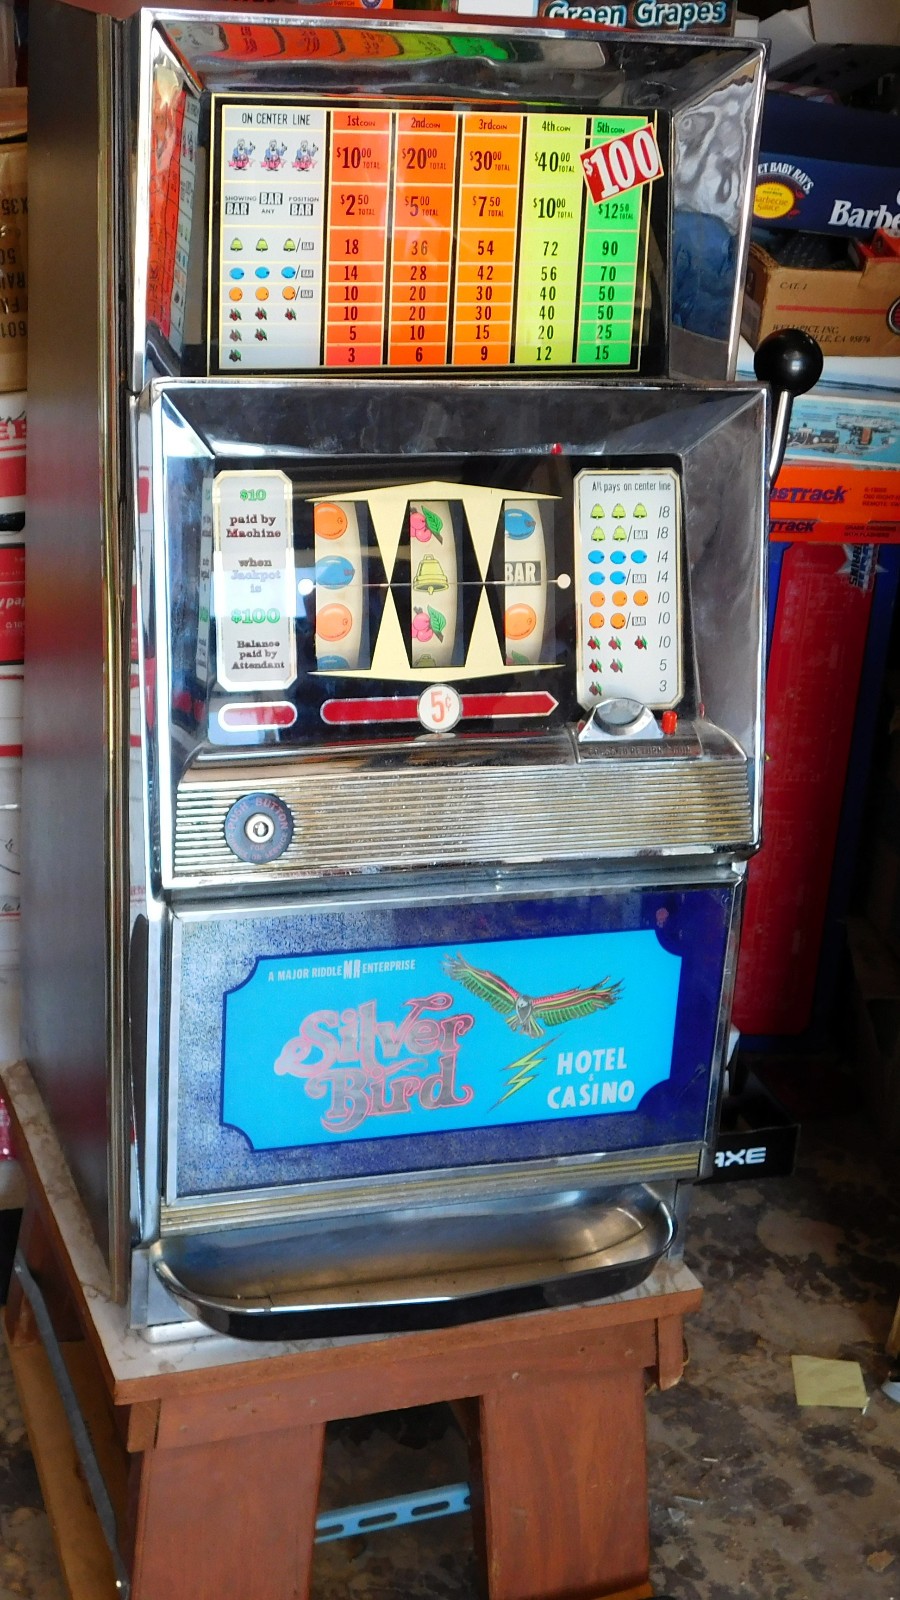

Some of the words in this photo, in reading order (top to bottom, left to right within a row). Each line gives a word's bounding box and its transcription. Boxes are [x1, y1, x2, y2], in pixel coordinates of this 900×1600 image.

[544, 2, 627, 27] Green
[633, 0, 727, 31] Grapes
[241, 113, 252, 124] ON
[256, 114, 288, 125] CENTER
[293, 114, 311, 126] LINE
[541, 120, 555, 132] 4th
[597, 122, 610, 133] 5th
[363, 161, 380, 169] TOTAL
[429, 162, 446, 170] TOTAL
[559, 165, 575, 173] TOTAL
[583, 130, 659, 198] $100
[770, 162, 795, 175] BABY
[260, 192, 283, 205] BAR
[226, 202, 249, 215] BAR
[290, 203, 313, 216] BAR
[345, 239, 359, 255] 18
[412, 240, 428, 256] 36
[477, 240, 494, 255] 54
[543, 241, 559, 256] 72
[602, 240, 618, 256] 90
[344, 265, 358, 280] 14
[410, 266, 427, 281] 28
[477, 266, 494, 281] 42
[541, 266, 557, 281] 56
[600, 266, 616, 281] 70
[344, 286, 358, 301] 10
[410, 286, 426, 301] 20
[476, 286, 492, 301] 30
[540, 286, 556, 301] 40
[599, 286, 615, 301] 50
[344, 306, 358, 321] 10
[409, 306, 426, 321] 20
[475, 306, 492, 321] 30
[539, 306, 554, 320] 40
[597, 306, 613, 320] 50
[350, 326, 356, 340] 5
[410, 325, 425, 340] 10
[476, 325, 490, 339] 15
[538, 325, 554, 339] 20
[596, 325, 612, 339] 25
[348, 347, 355, 363] 3
[415, 347, 423, 362] 6
[480, 346, 488, 361] 9
[536, 346, 552, 360] 12
[595, 345, 609, 360] 15
[592, 481, 602, 491] All
[603, 483, 621, 494] pays
[623, 483, 632, 491] on
[634, 482, 656, 491] center
[658, 482, 671, 491] line
[240, 489, 267, 501] $10
[658, 505, 670, 519] 18
[230, 514, 257, 526] paid
[261, 514, 276, 528] by
[226, 528, 281, 538] Machine
[657, 527, 669, 539] 18
[238, 558, 272, 567] when
[657, 550, 668, 563] 14
[231, 570, 281, 582] Jackpot
[505, 562, 536, 585] BAR
[657, 571, 668, 583] 14
[250, 584, 262, 593] is
[657, 591, 670, 604] 10
[231, 607, 281, 624] $100
[658, 612, 671, 625] 10
[236, 640, 280, 649] Balance
[659, 636, 671, 649] 10
[239, 650, 262, 660] paid
[264, 650, 278, 660] by
[231, 661, 285, 670] Attendant
[659, 659, 667, 671] 5
[659, 680, 667, 692] 3
[431, 691, 451, 722] 5¢
[228, 802, 249, 830] PUSH
[255, 797, 289, 829] BUTTON
[268, 971, 275, 982] A
[277, 969, 309, 981] MAJOR
[311, 965, 342, 978] RIDDLE
[362, 959, 416, 974] ENTERPRISE
[274, 993, 474, 1078] Silver
[556, 1047, 628, 1076] HOTEL
[304, 1051, 474, 1133] Bird
[547, 1080, 635, 1109] CASINO
